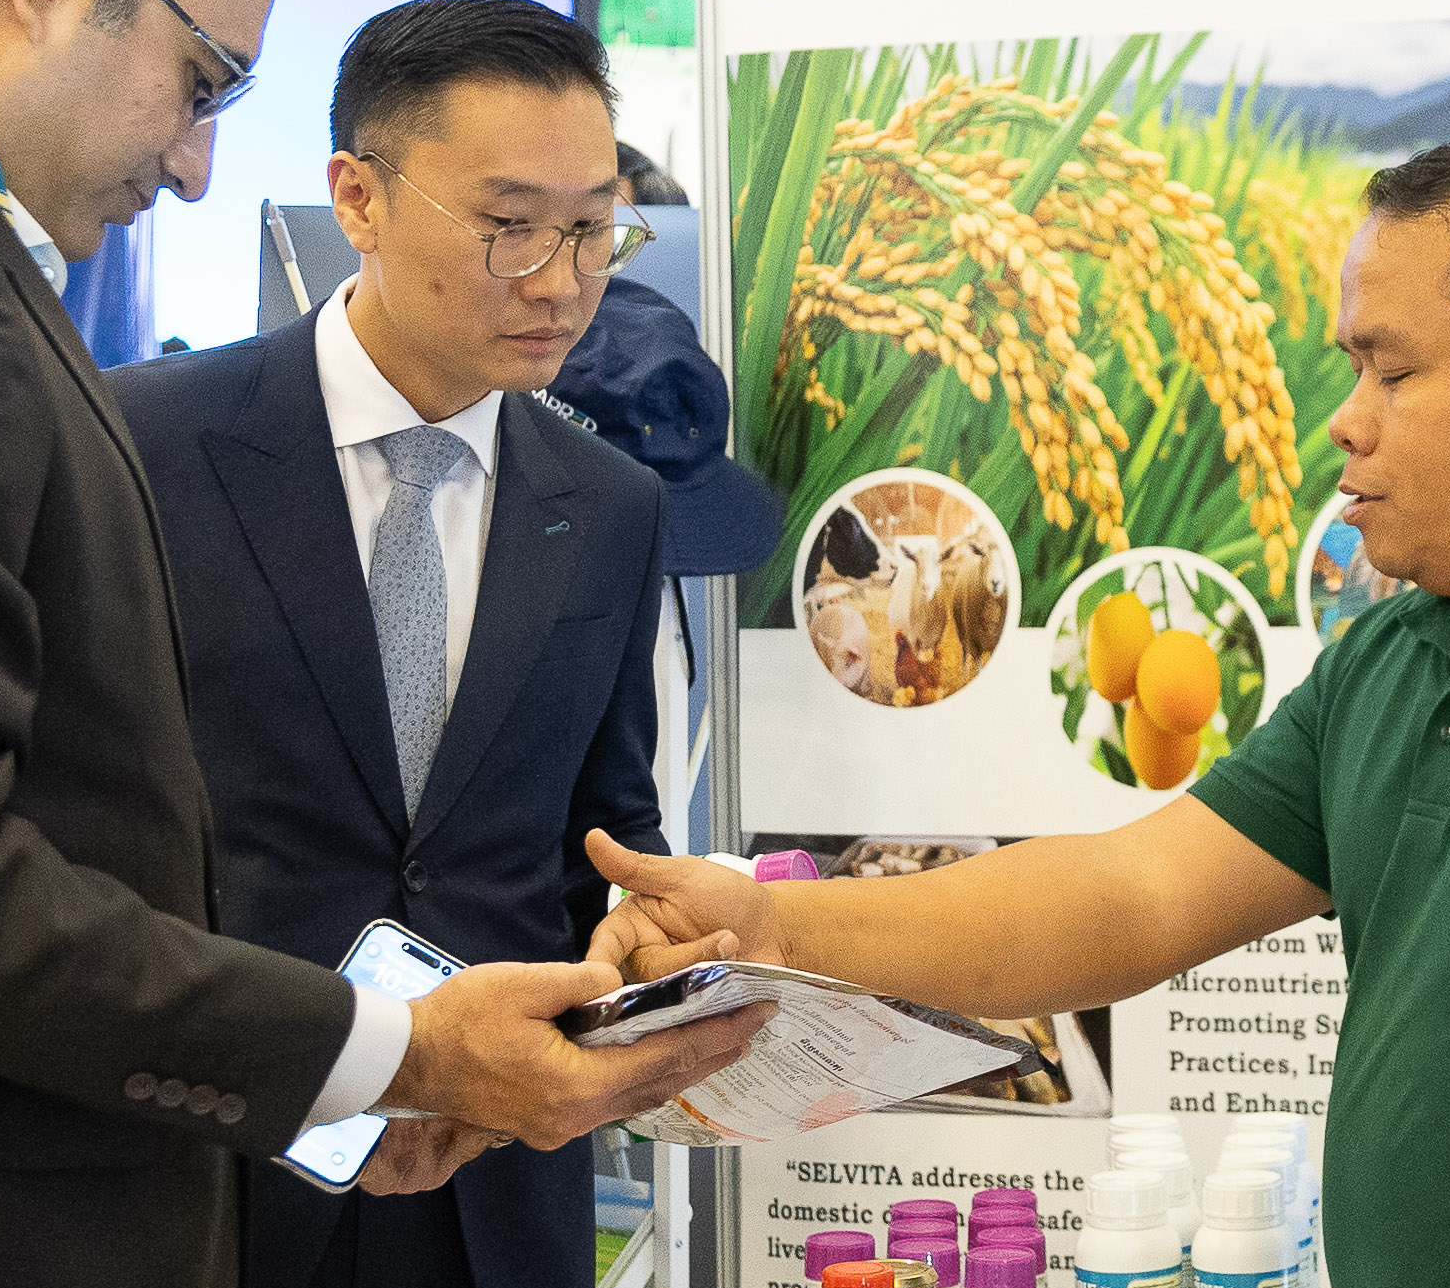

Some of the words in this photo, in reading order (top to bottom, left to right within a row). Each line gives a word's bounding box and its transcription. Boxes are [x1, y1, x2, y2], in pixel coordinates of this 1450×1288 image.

[531, 388, 598, 433] APRED
[1168, 1010, 1307, 1041] Promoting
[1169, 1049, 1298, 1079] Practices,
[1169, 1091, 1216, 1113] and
[1225, 1091, 1326, 1116] Enhanc
[786, 1159, 903, 1186] “SELVITA
[911, 1166, 1035, 1190] addresses
[1043, 1170, 1085, 1192] the
[766, 1198, 873, 1226] domestic
[766, 1236, 806, 1260] live
